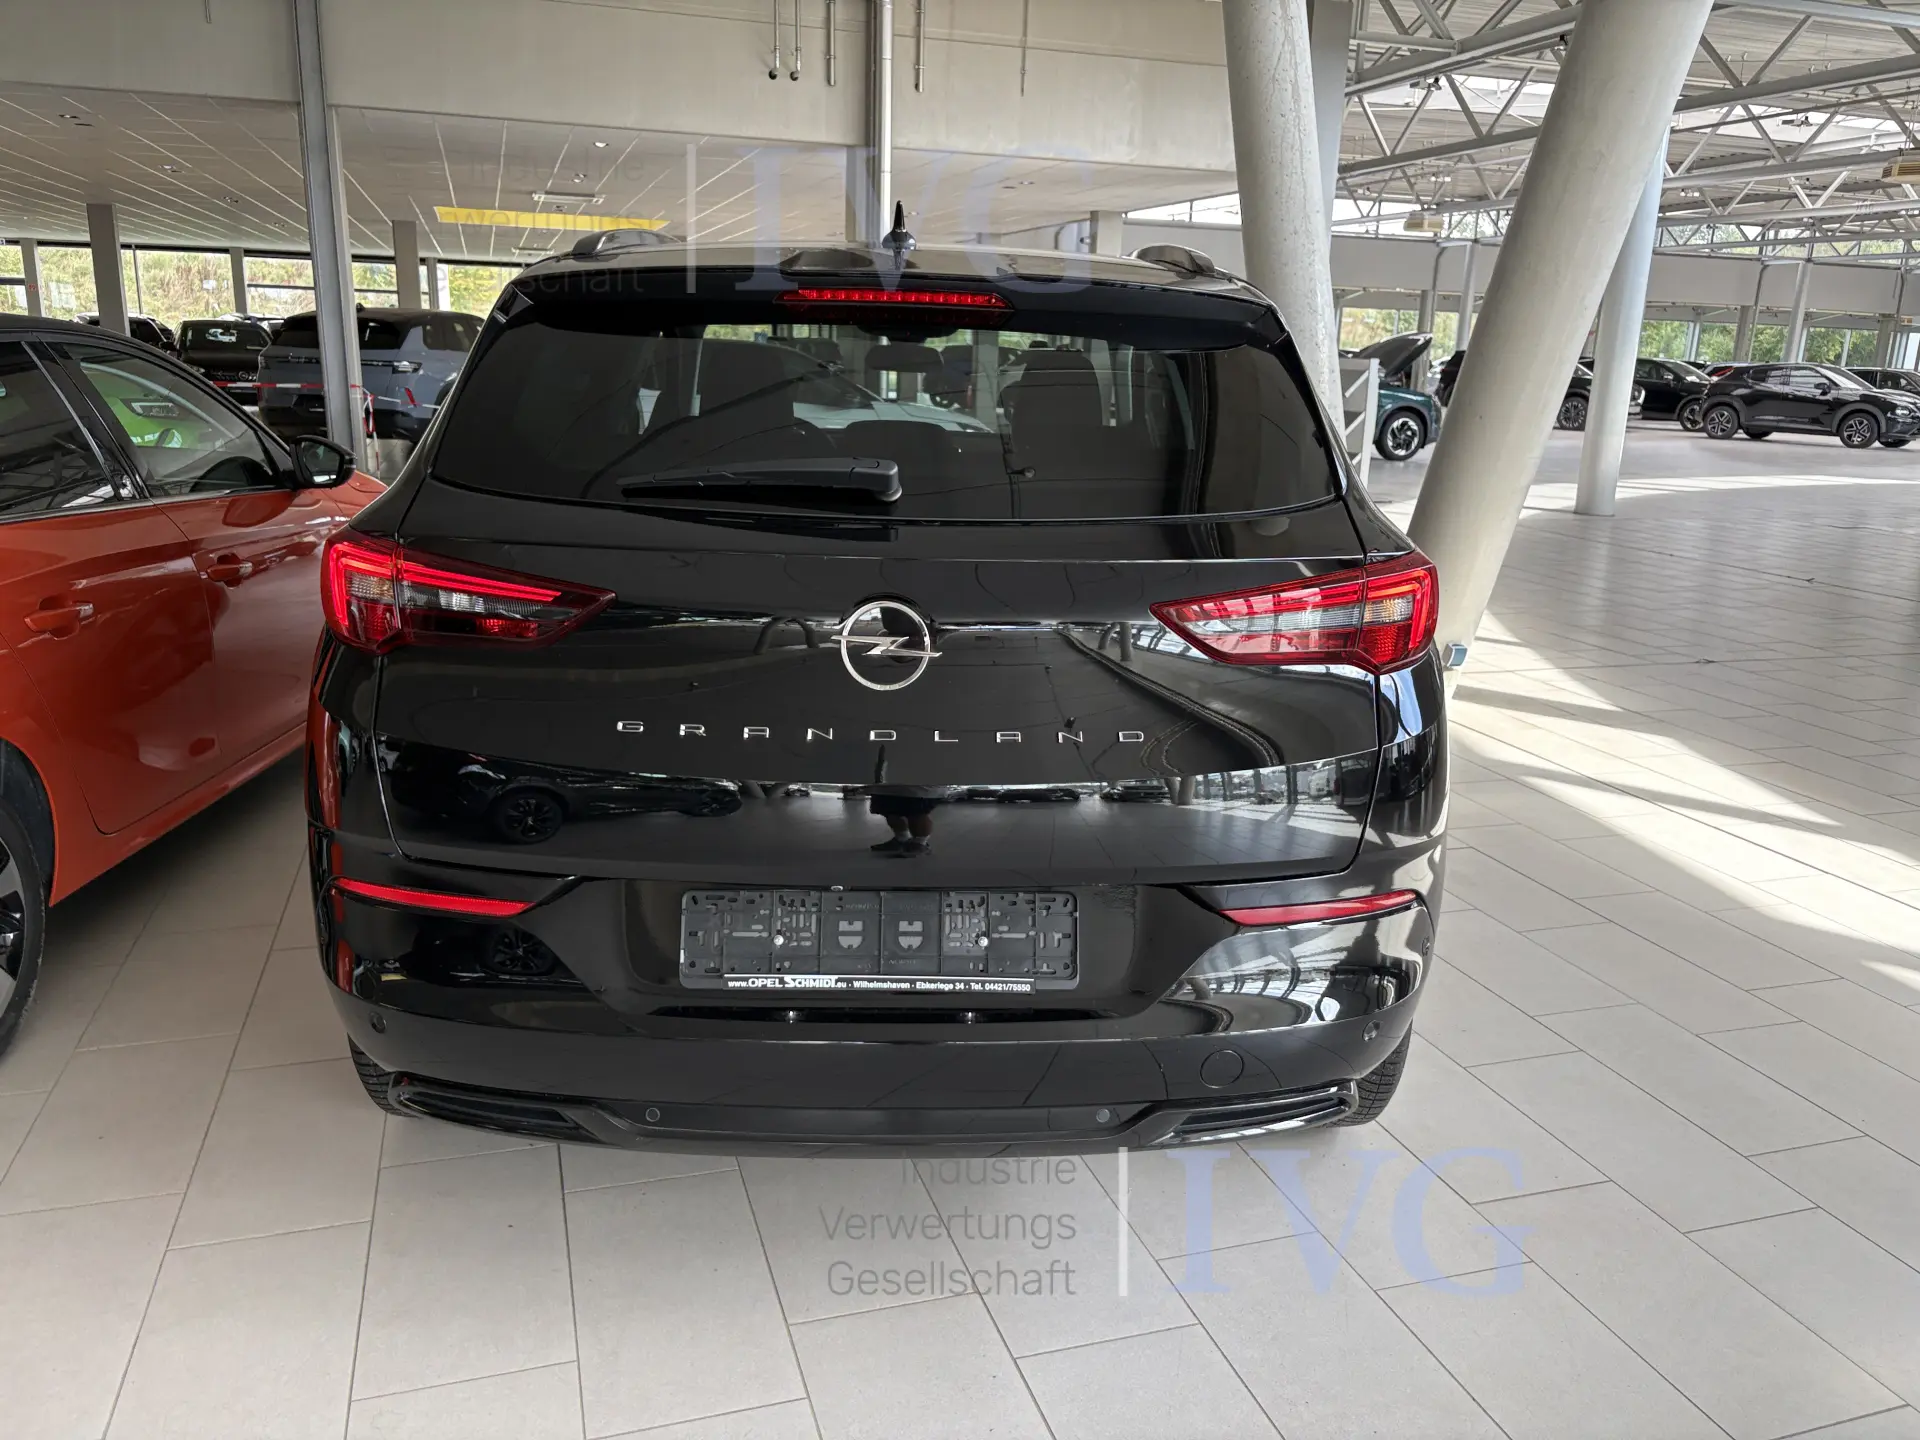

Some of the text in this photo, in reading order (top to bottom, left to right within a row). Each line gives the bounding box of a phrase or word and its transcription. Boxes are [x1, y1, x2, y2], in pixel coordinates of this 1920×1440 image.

[616, 719, 1145, 744] GRANDLAND
[853, 980, 910, 989] Wilhelmshaven
[955, 982, 964, 990] 34
[970, 982, 983, 991] Tel.
[985, 983, 1031, 992] 04421/75550
